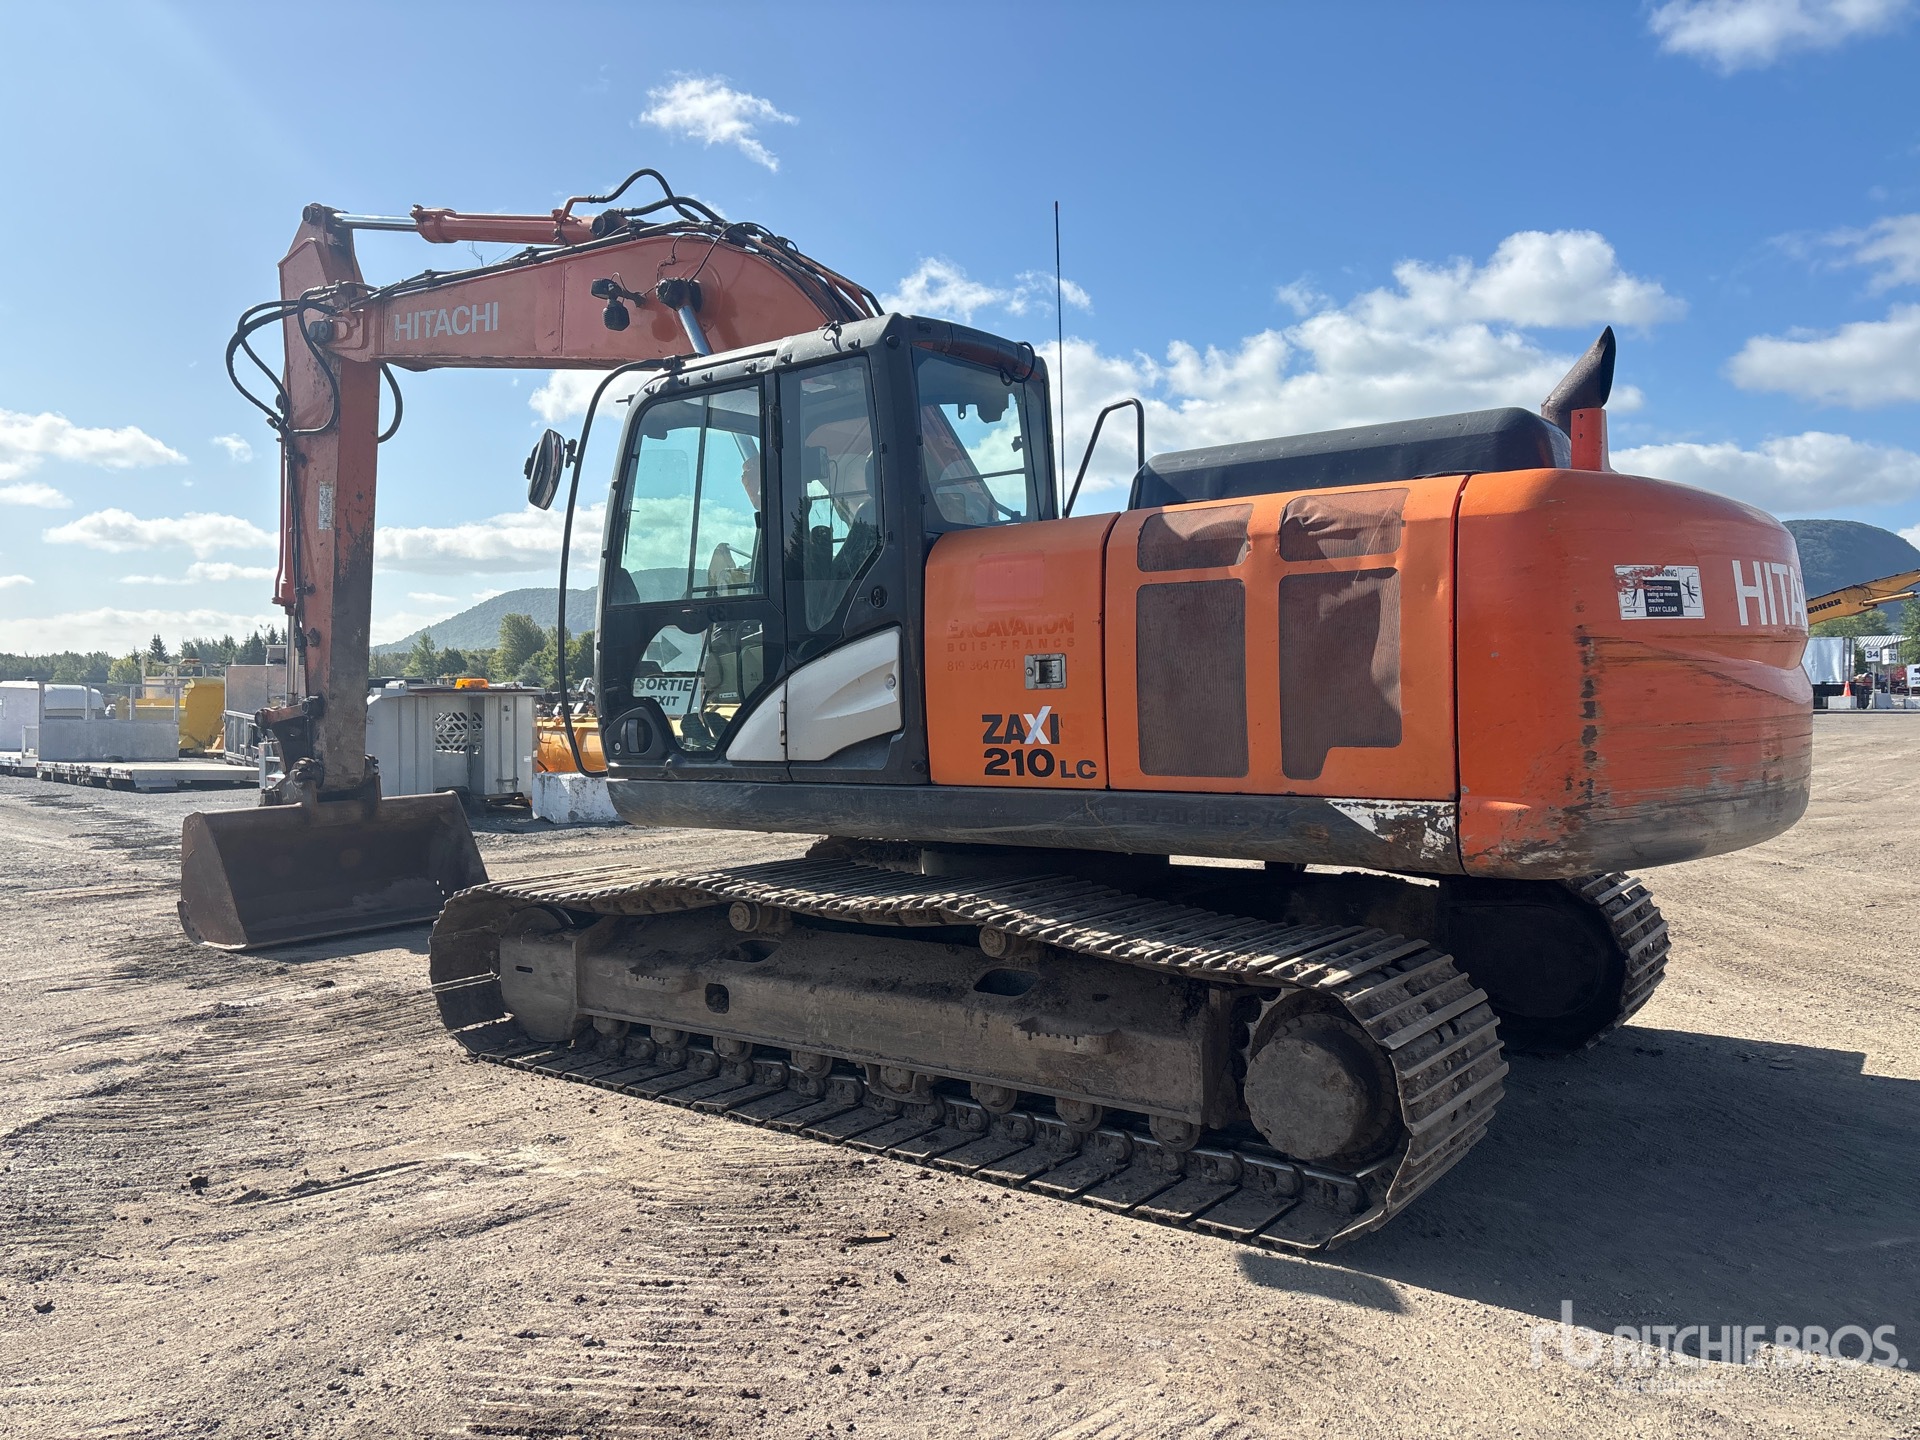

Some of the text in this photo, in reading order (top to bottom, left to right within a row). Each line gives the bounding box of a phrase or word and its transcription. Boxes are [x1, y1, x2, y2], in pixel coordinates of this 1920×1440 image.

[394, 301, 499, 341] HITACHI
[1732, 560, 1808, 626] HITA
[1807, 598, 1842, 615] BHERR
[1866, 650, 1879, 659] 34
[1889, 653, 1897, 661] 33
[638, 678, 693, 691] SORTIE
[983, 747, 1097, 779] 210 LC
